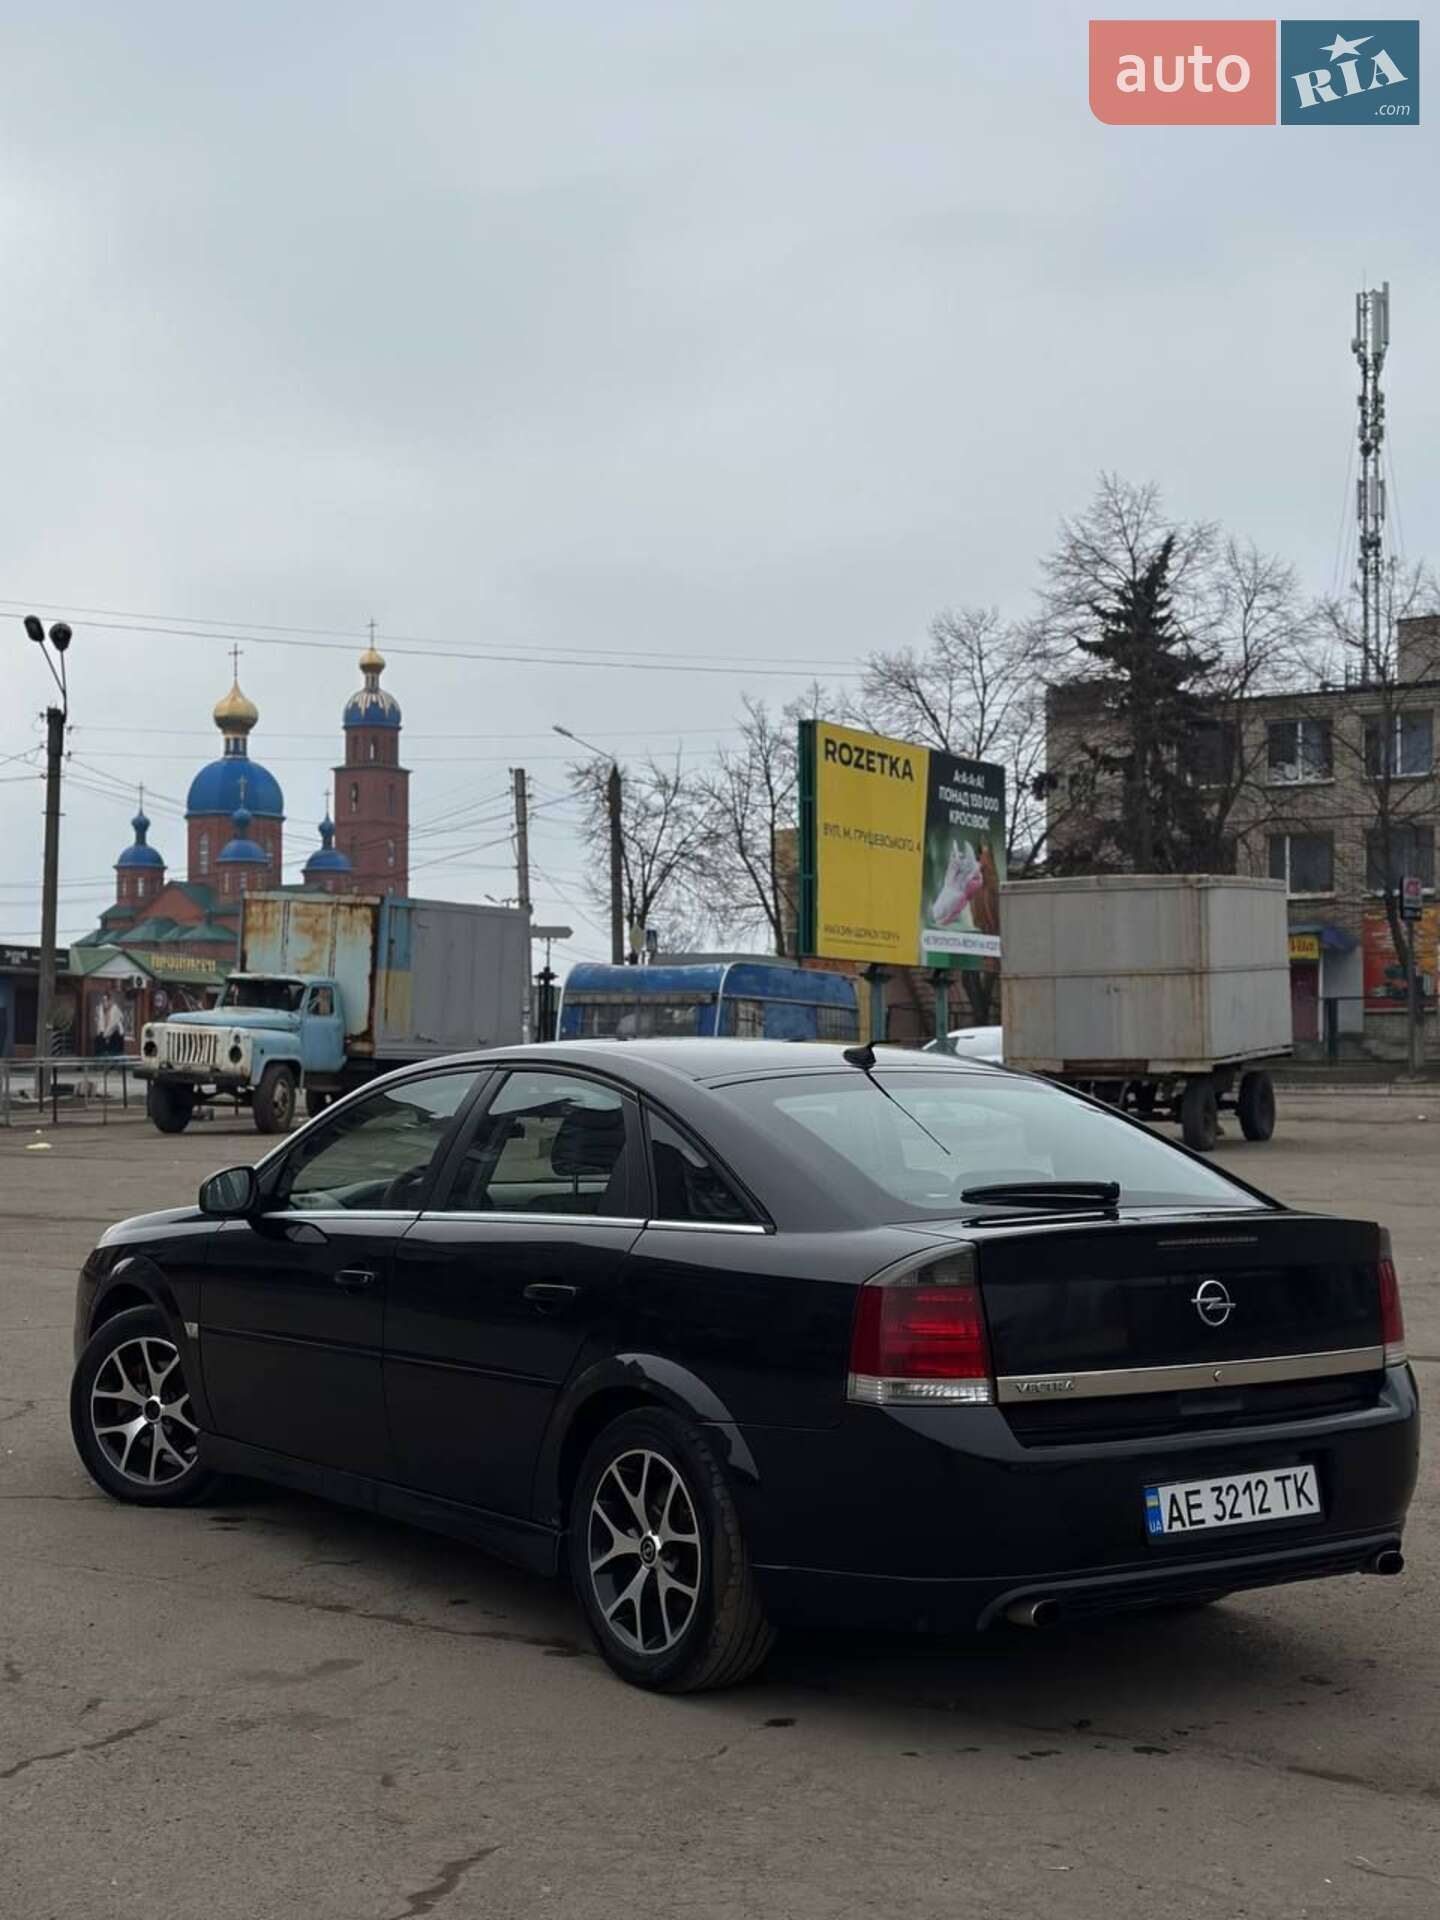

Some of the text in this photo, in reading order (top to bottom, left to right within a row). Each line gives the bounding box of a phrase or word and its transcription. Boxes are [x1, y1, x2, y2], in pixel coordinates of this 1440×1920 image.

[824, 738, 914, 782] ROZETKA
[938, 785, 970, 809] ПОНАД
[1015, 1379, 1075, 1393] VECTRA
[1168, 1471, 1314, 1530] AE 3212 TK
[1150, 1520, 1163, 1533] UA
